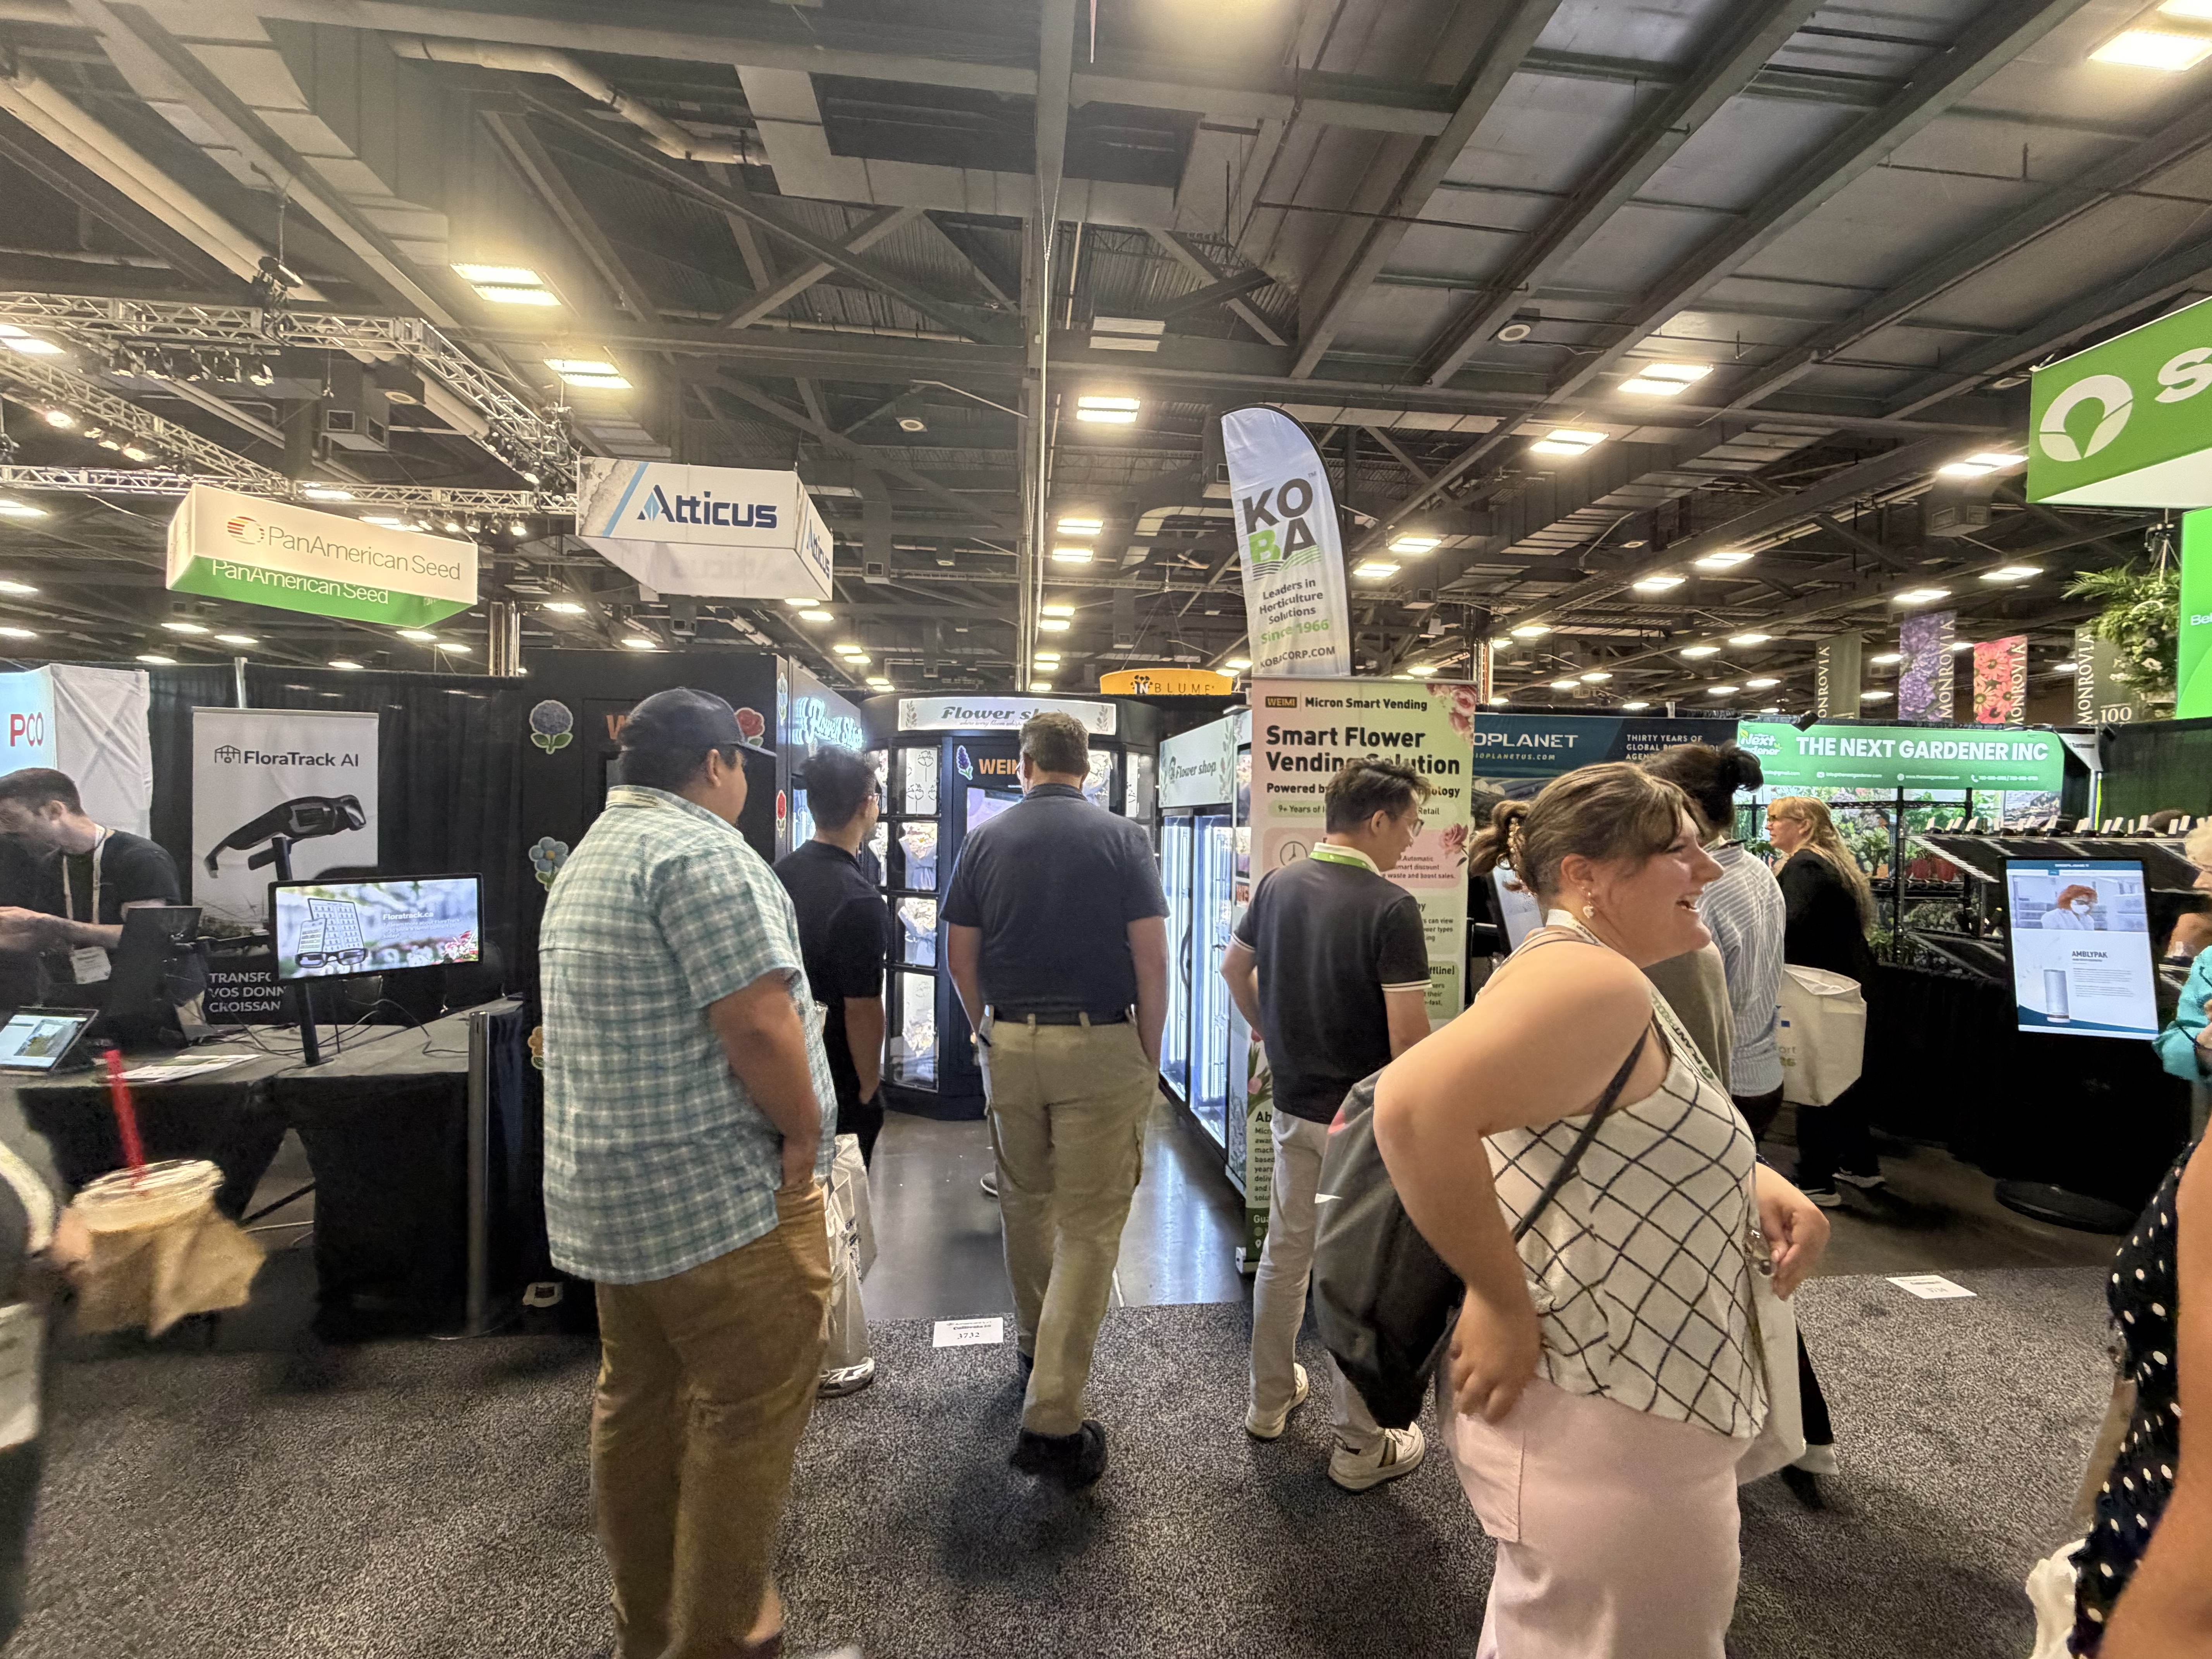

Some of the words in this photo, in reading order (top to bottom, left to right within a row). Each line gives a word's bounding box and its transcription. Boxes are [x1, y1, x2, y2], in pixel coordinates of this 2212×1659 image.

[637, 484, 777, 529] Atticus
[269, 526, 408, 571] PanAmerican
[412, 555, 461, 580] Seed
[807, 519, 830, 580] Atticus
[212, 559, 340, 596] PanAmerican
[343, 583, 388, 605] Seed
[1263, 582, 1303, 600] Leaders
[1305, 579, 1316, 588] in
[1259, 592, 1324, 615] Horticulture
[1269, 606, 1317, 625] Solutions
[1261, 626, 1293, 645] Since
[1295, 619, 1329, 634] 1966
[1939, 620, 1955, 719] MONROVIA
[2077, 634, 2095, 725] MONROVIA
[1817, 646, 1831, 718] ONROVIA
[941, 706, 1015, 720] Flower
[1267, 697, 1296, 707] WEIMI
[1305, 697, 1343, 708] Micron
[1346, 698, 1380, 709] Smart
[1383, 699, 1427, 712] Vending
[2100, 706, 2132, 723] 100
[10, 712, 44, 747] PCO
[1266, 725, 1338, 746] Smart
[1345, 726, 1426, 748] Flower
[1740, 733, 1776, 746] Next
[1473, 733, 1578, 748] OPLANET
[1796, 737, 1836, 756] THE
[1840, 738, 1896, 758] NEXT
[1899, 740, 2009, 761] GARDENER
[2011, 742, 2049, 761] INC
[244, 750, 336, 767] FloraTrack
[341, 753, 359, 767] AI
[1266, 751, 1360, 772] Vendin
[1475, 752, 1556, 761] IOPLANETUS.COM
[1175, 764, 1198, 780] Flower
[1199, 760, 1217, 777] shop
[1266, 783, 1316, 793] Powered
[1318, 783, 1328, 793] b
[1289, 805, 1311, 813] Years
[1313, 805, 1321, 813] of
[1418, 807, 1440, 815] Retail
[383, 912, 434, 921] Floratrack.ca
[1429, 965, 1455, 975] ffline)
[208, 987, 239, 998] VOS
[243, 986, 287, 997] DONN
[209, 1001, 281, 1013] CROISSAN
